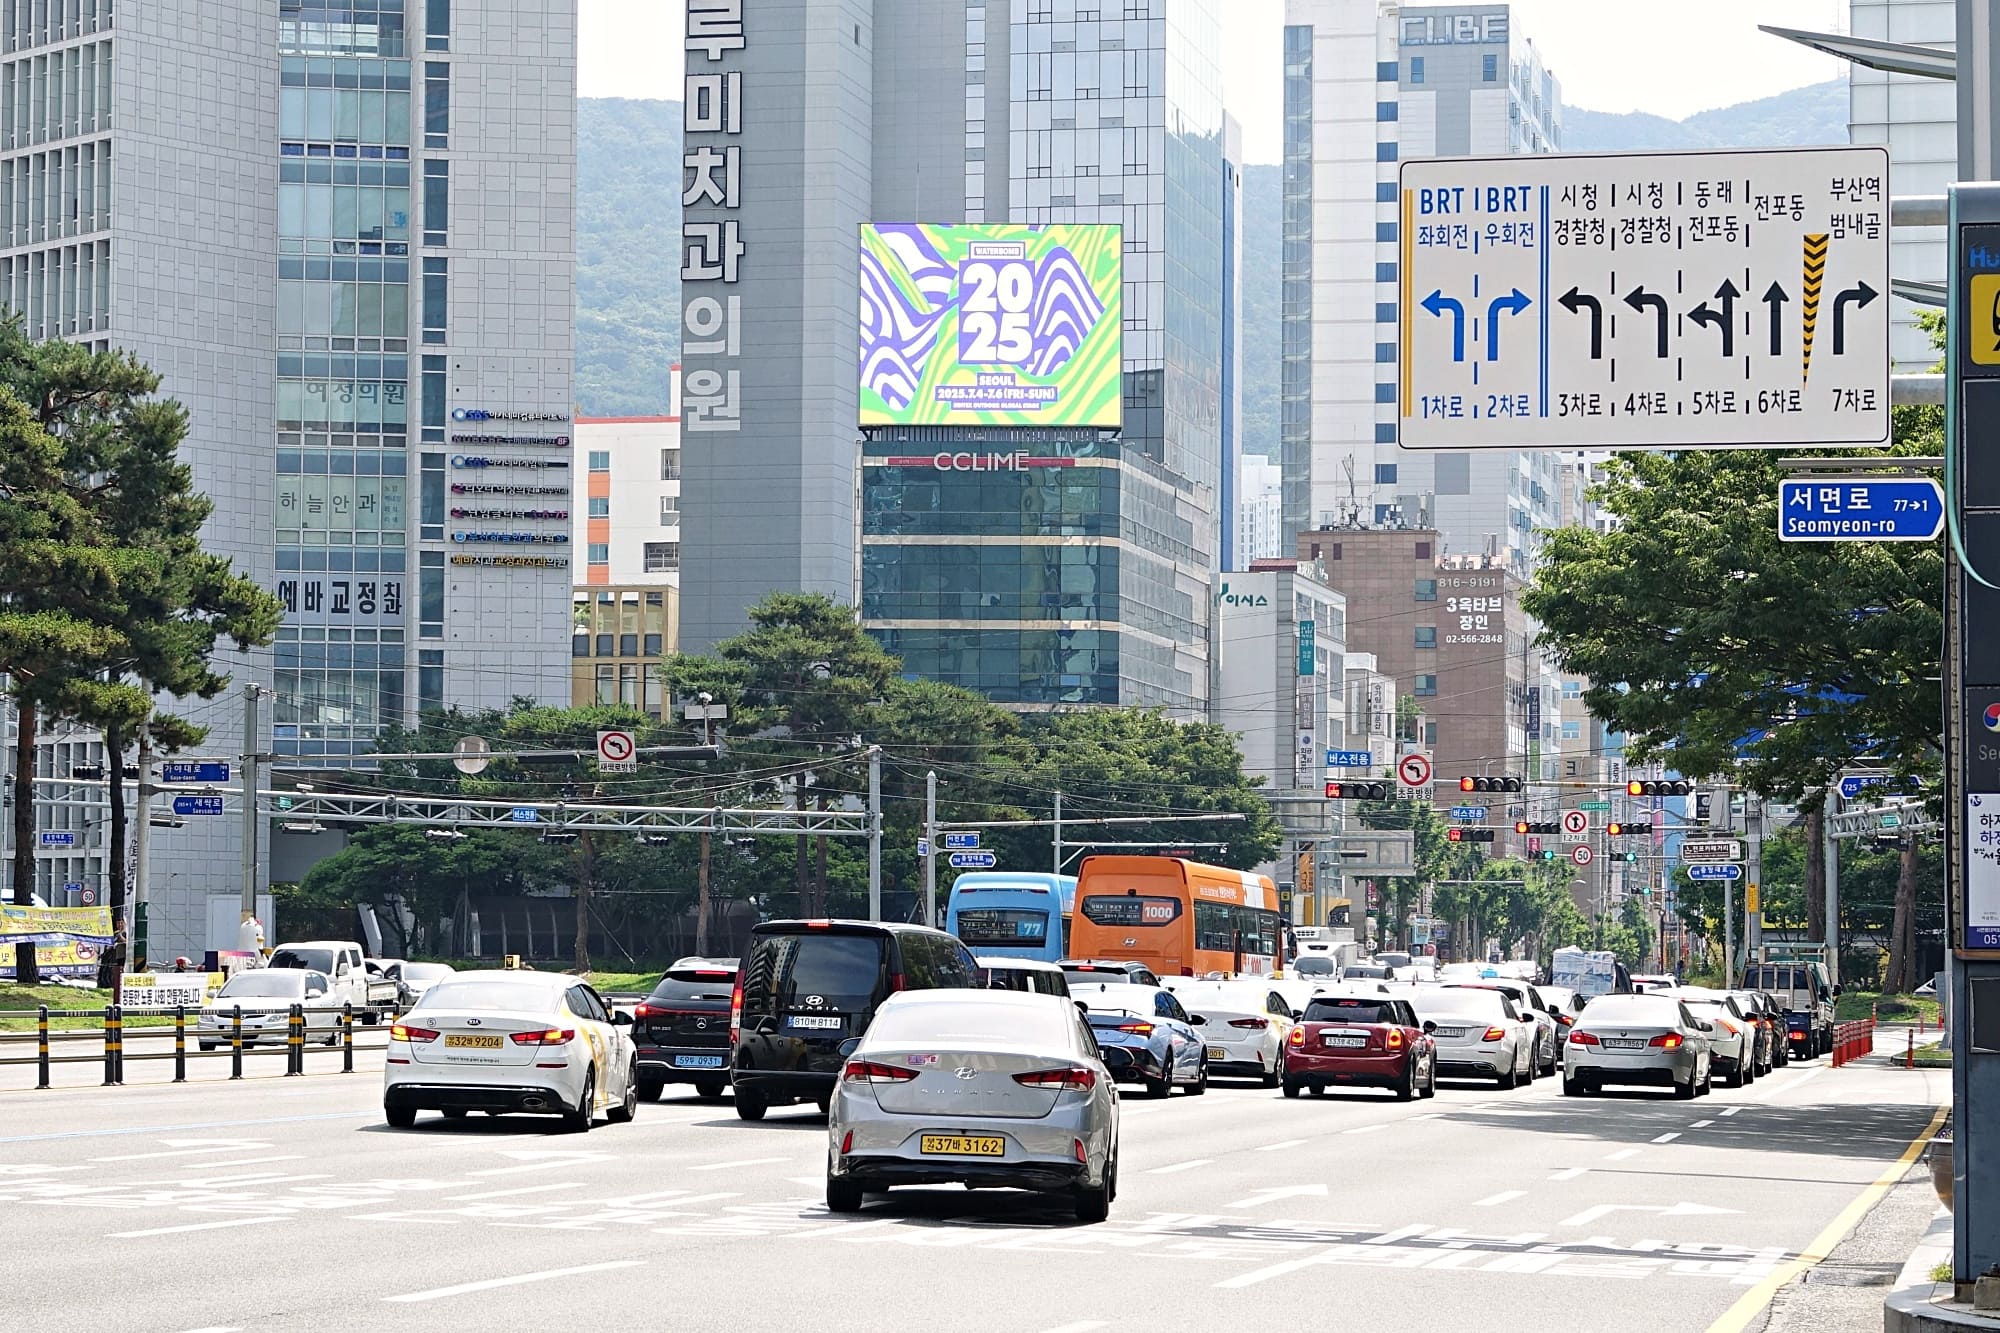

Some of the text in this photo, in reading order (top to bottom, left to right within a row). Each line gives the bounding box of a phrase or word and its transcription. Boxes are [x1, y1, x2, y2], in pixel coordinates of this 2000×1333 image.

[1400, 14, 1507, 45] CUBE
[1486, 185, 1531, 212] BRT
[1560, 184, 1598, 210] 시청
[1626, 182, 1664, 209] 시청
[1695, 180, 1732, 208] 동래
[1830, 176, 1881, 201] 부산역
[1420, 187, 1465, 214] BRT
[1754, 194, 1806, 222] 전포동
[1418, 224, 1468, 248] 좌회전
[1484, 223, 1534, 246] 우회전
[1554, 219, 1606, 245] 경찰청
[1620, 216, 1672, 244] 경찰청
[1689, 216, 1740, 243] 전포동
[1830, 213, 1881, 240] 범내골
[962, 262, 1034, 313] 20
[960, 312, 1033, 362] 25
[980, 376, 1014, 386] SEOUL
[306, 382, 406, 405] 여성의원
[1558, 392, 1602, 416] 3차로
[1624, 391, 1668, 415] 4차로
[1692, 390, 1736, 415] 5차로
[1758, 389, 1802, 414] 6차로
[1832, 388, 1877, 412] 7차로
[1421, 395, 1464, 419] 1차로
[1486, 394, 1531, 418] 2차로
[281, 492, 376, 514] 하늘안과
[1790, 488, 1872, 514] 서면로
[1788, 518, 1896, 536] Seomyeon-ro
[1439, 578, 1496, 588] 816-9191
[1226, 594, 1268, 607] 이시스
[1446, 596, 1502, 614] 3옥타브
[1460, 614, 1488, 630] 장인
[1446, 634, 1503, 644] 02-566-2848
[164, 764, 202, 774] 가야대로
[601, 763, 636, 772] 새싹로방향
[1329, 753, 1369, 766] 버스전용
[194, 798, 221, 808] 새싹로
[1398, 788, 1432, 800] 초읍방향
[1453, 808, 1483, 818] 버스전용
[1577, 851, 1588, 860] 50
[1145, 906, 1172, 918] 1000
[1024, 923, 1041, 935] 77
[1984, 934, 2000, 944] 05
[475, 1037, 500, 1046] 9204
[920, 1088, 1011, 1096] SONATA
[964, 1138, 998, 1152] 3162
